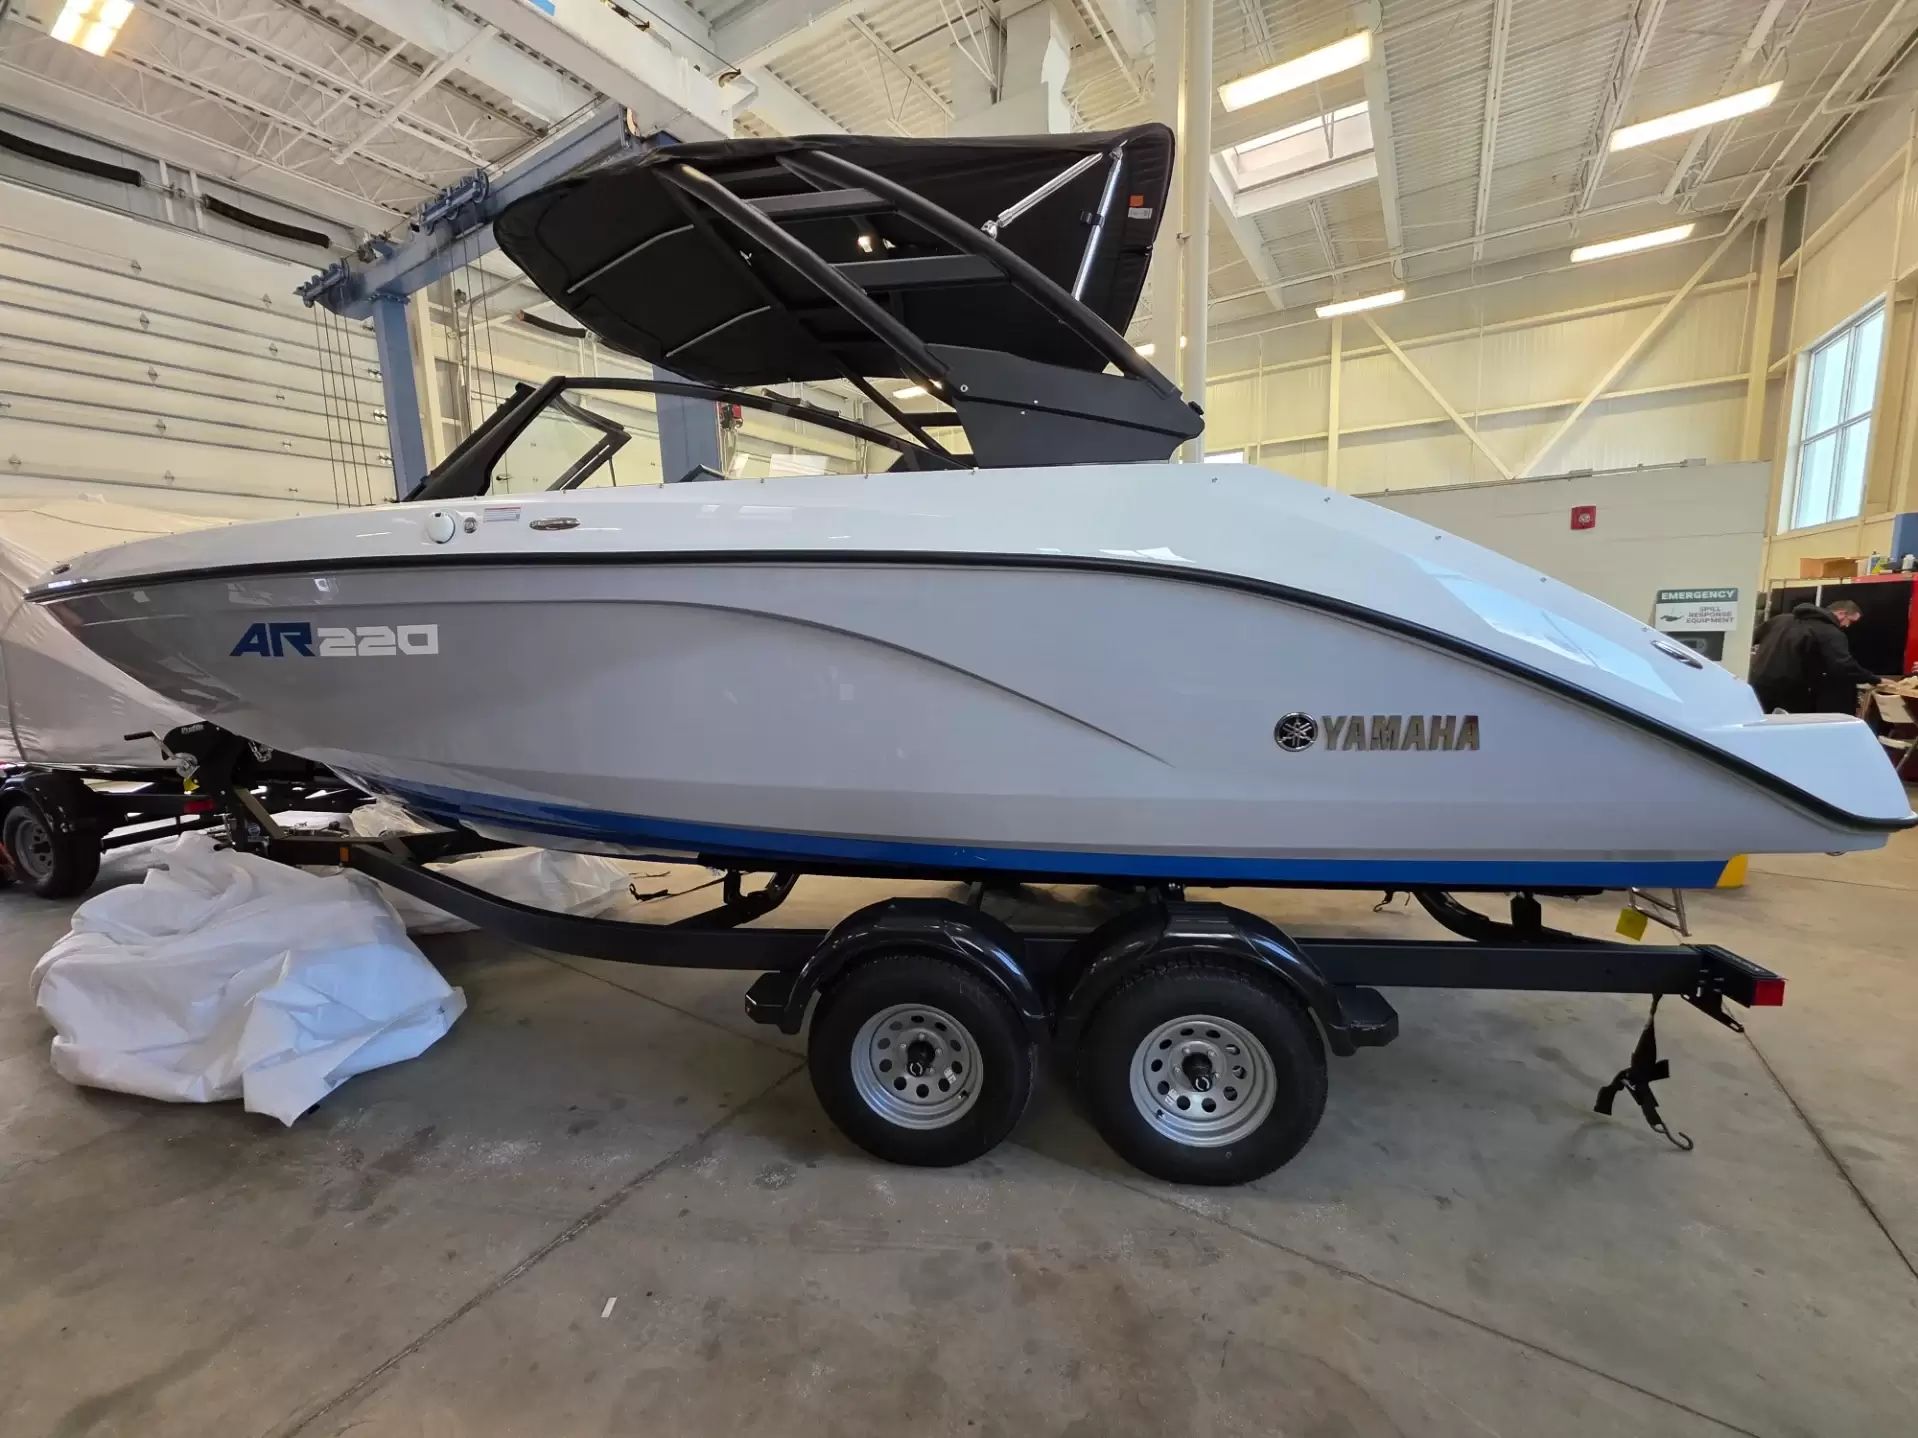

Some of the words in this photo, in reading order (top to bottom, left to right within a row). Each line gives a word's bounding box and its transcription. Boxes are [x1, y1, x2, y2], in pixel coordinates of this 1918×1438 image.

[1661, 590, 1735, 600] EMERGENCY
[229, 622, 439, 657] AR220
[1321, 715, 1481, 751] YAMAHA
